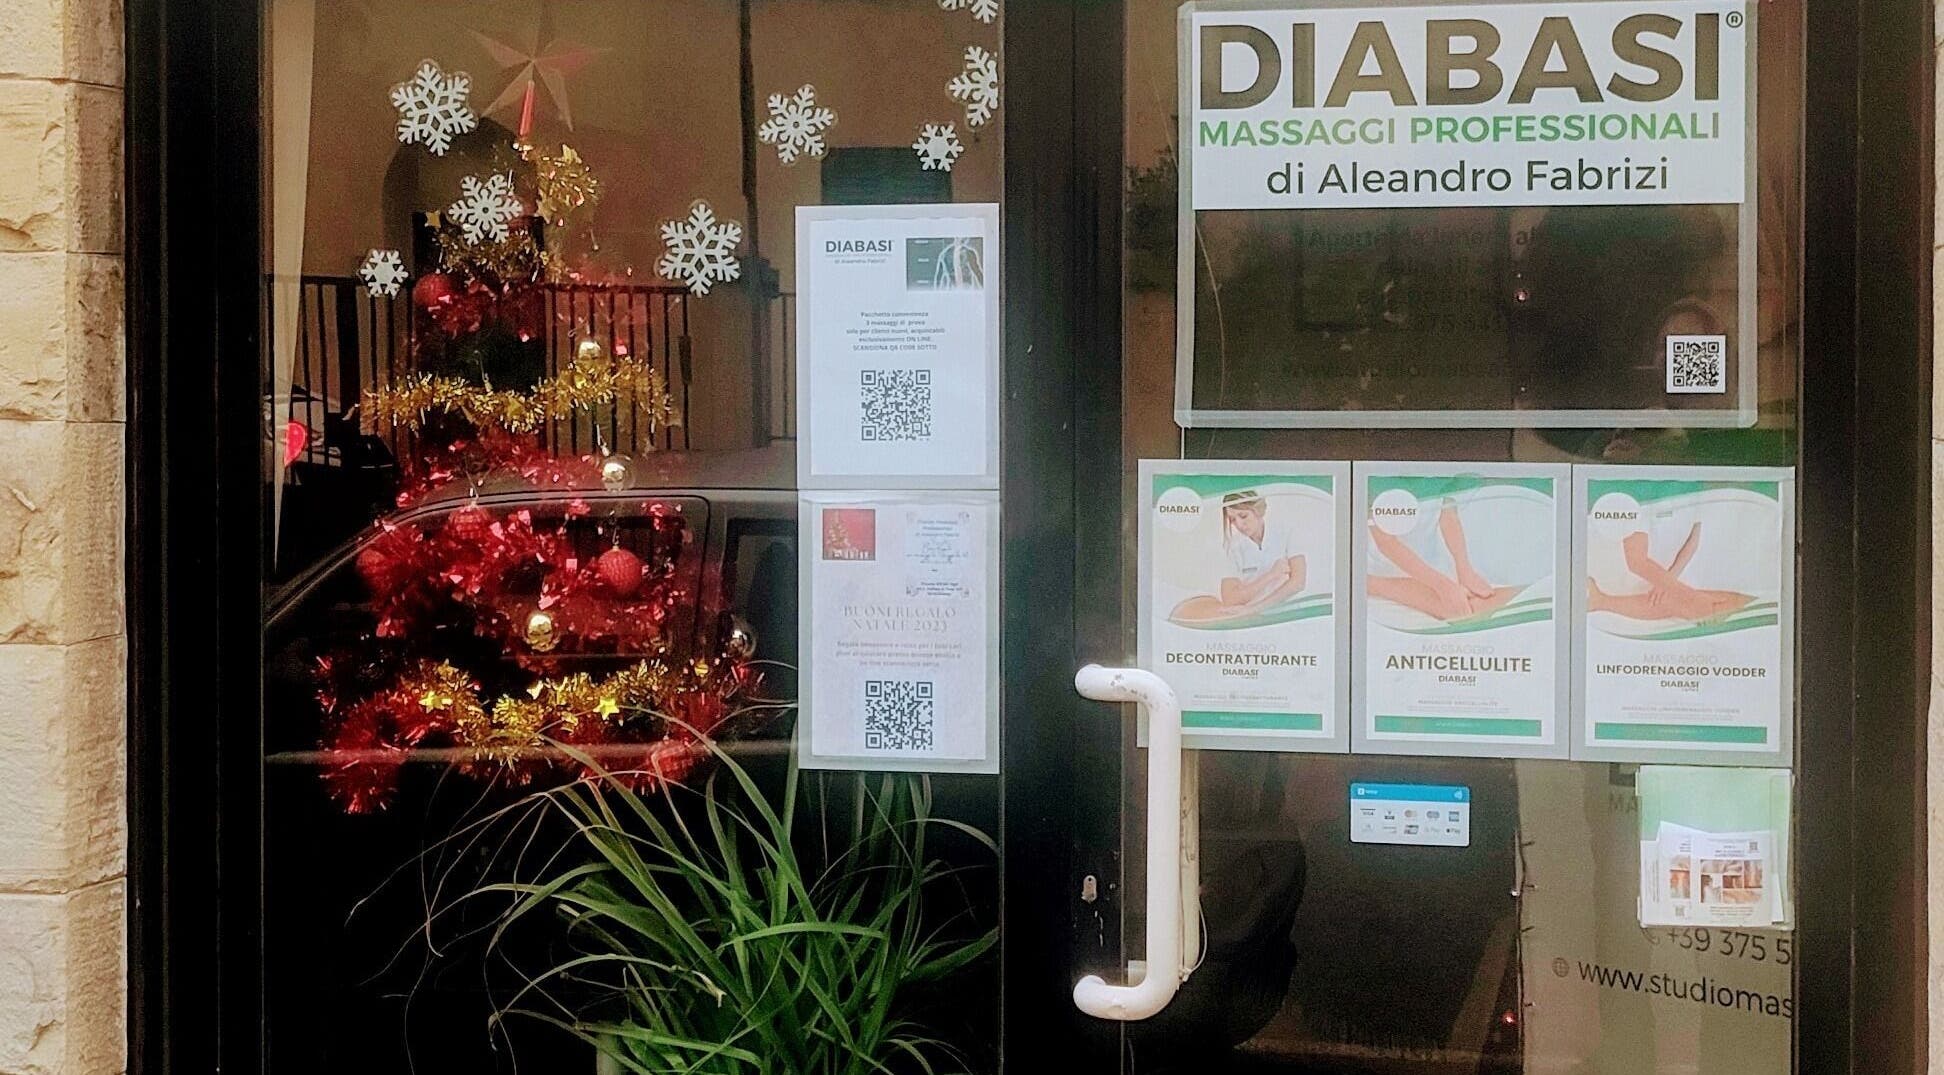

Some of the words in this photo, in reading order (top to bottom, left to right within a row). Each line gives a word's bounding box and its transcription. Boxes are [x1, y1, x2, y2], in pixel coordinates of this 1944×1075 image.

[1199, 118, 1396, 147] MASSAGGI
[1409, 112, 1720, 144] PROFESSIONALI
[1266, 162, 1304, 194] di
[1318, 160, 1512, 194] Aleandro
[1526, 156, 1669, 191] Fabrizi
[825, 240, 892, 253] DIABASI
[1159, 505, 1200, 515] DIABASI
[1375, 507, 1417, 517] DIABASI
[1594, 511, 1638, 521] DIABASI
[1165, 652, 1317, 667] DECONTRATTURANTE
[1385, 654, 1532, 673] ANTICELLULITE
[1222, 668, 1260, 677] DIABASI
[1596, 664, 1710, 677] LINFODRENAGGIO
[1712, 666, 1766, 678] VODDER
[1438, 675, 1477, 683] DIABASI
[1660, 680, 1700, 689] DIABASI
[1668, 926, 1711, 952] +39
[1720, 930, 1767, 962] 375
[1776, 938, 1792, 965] 5
